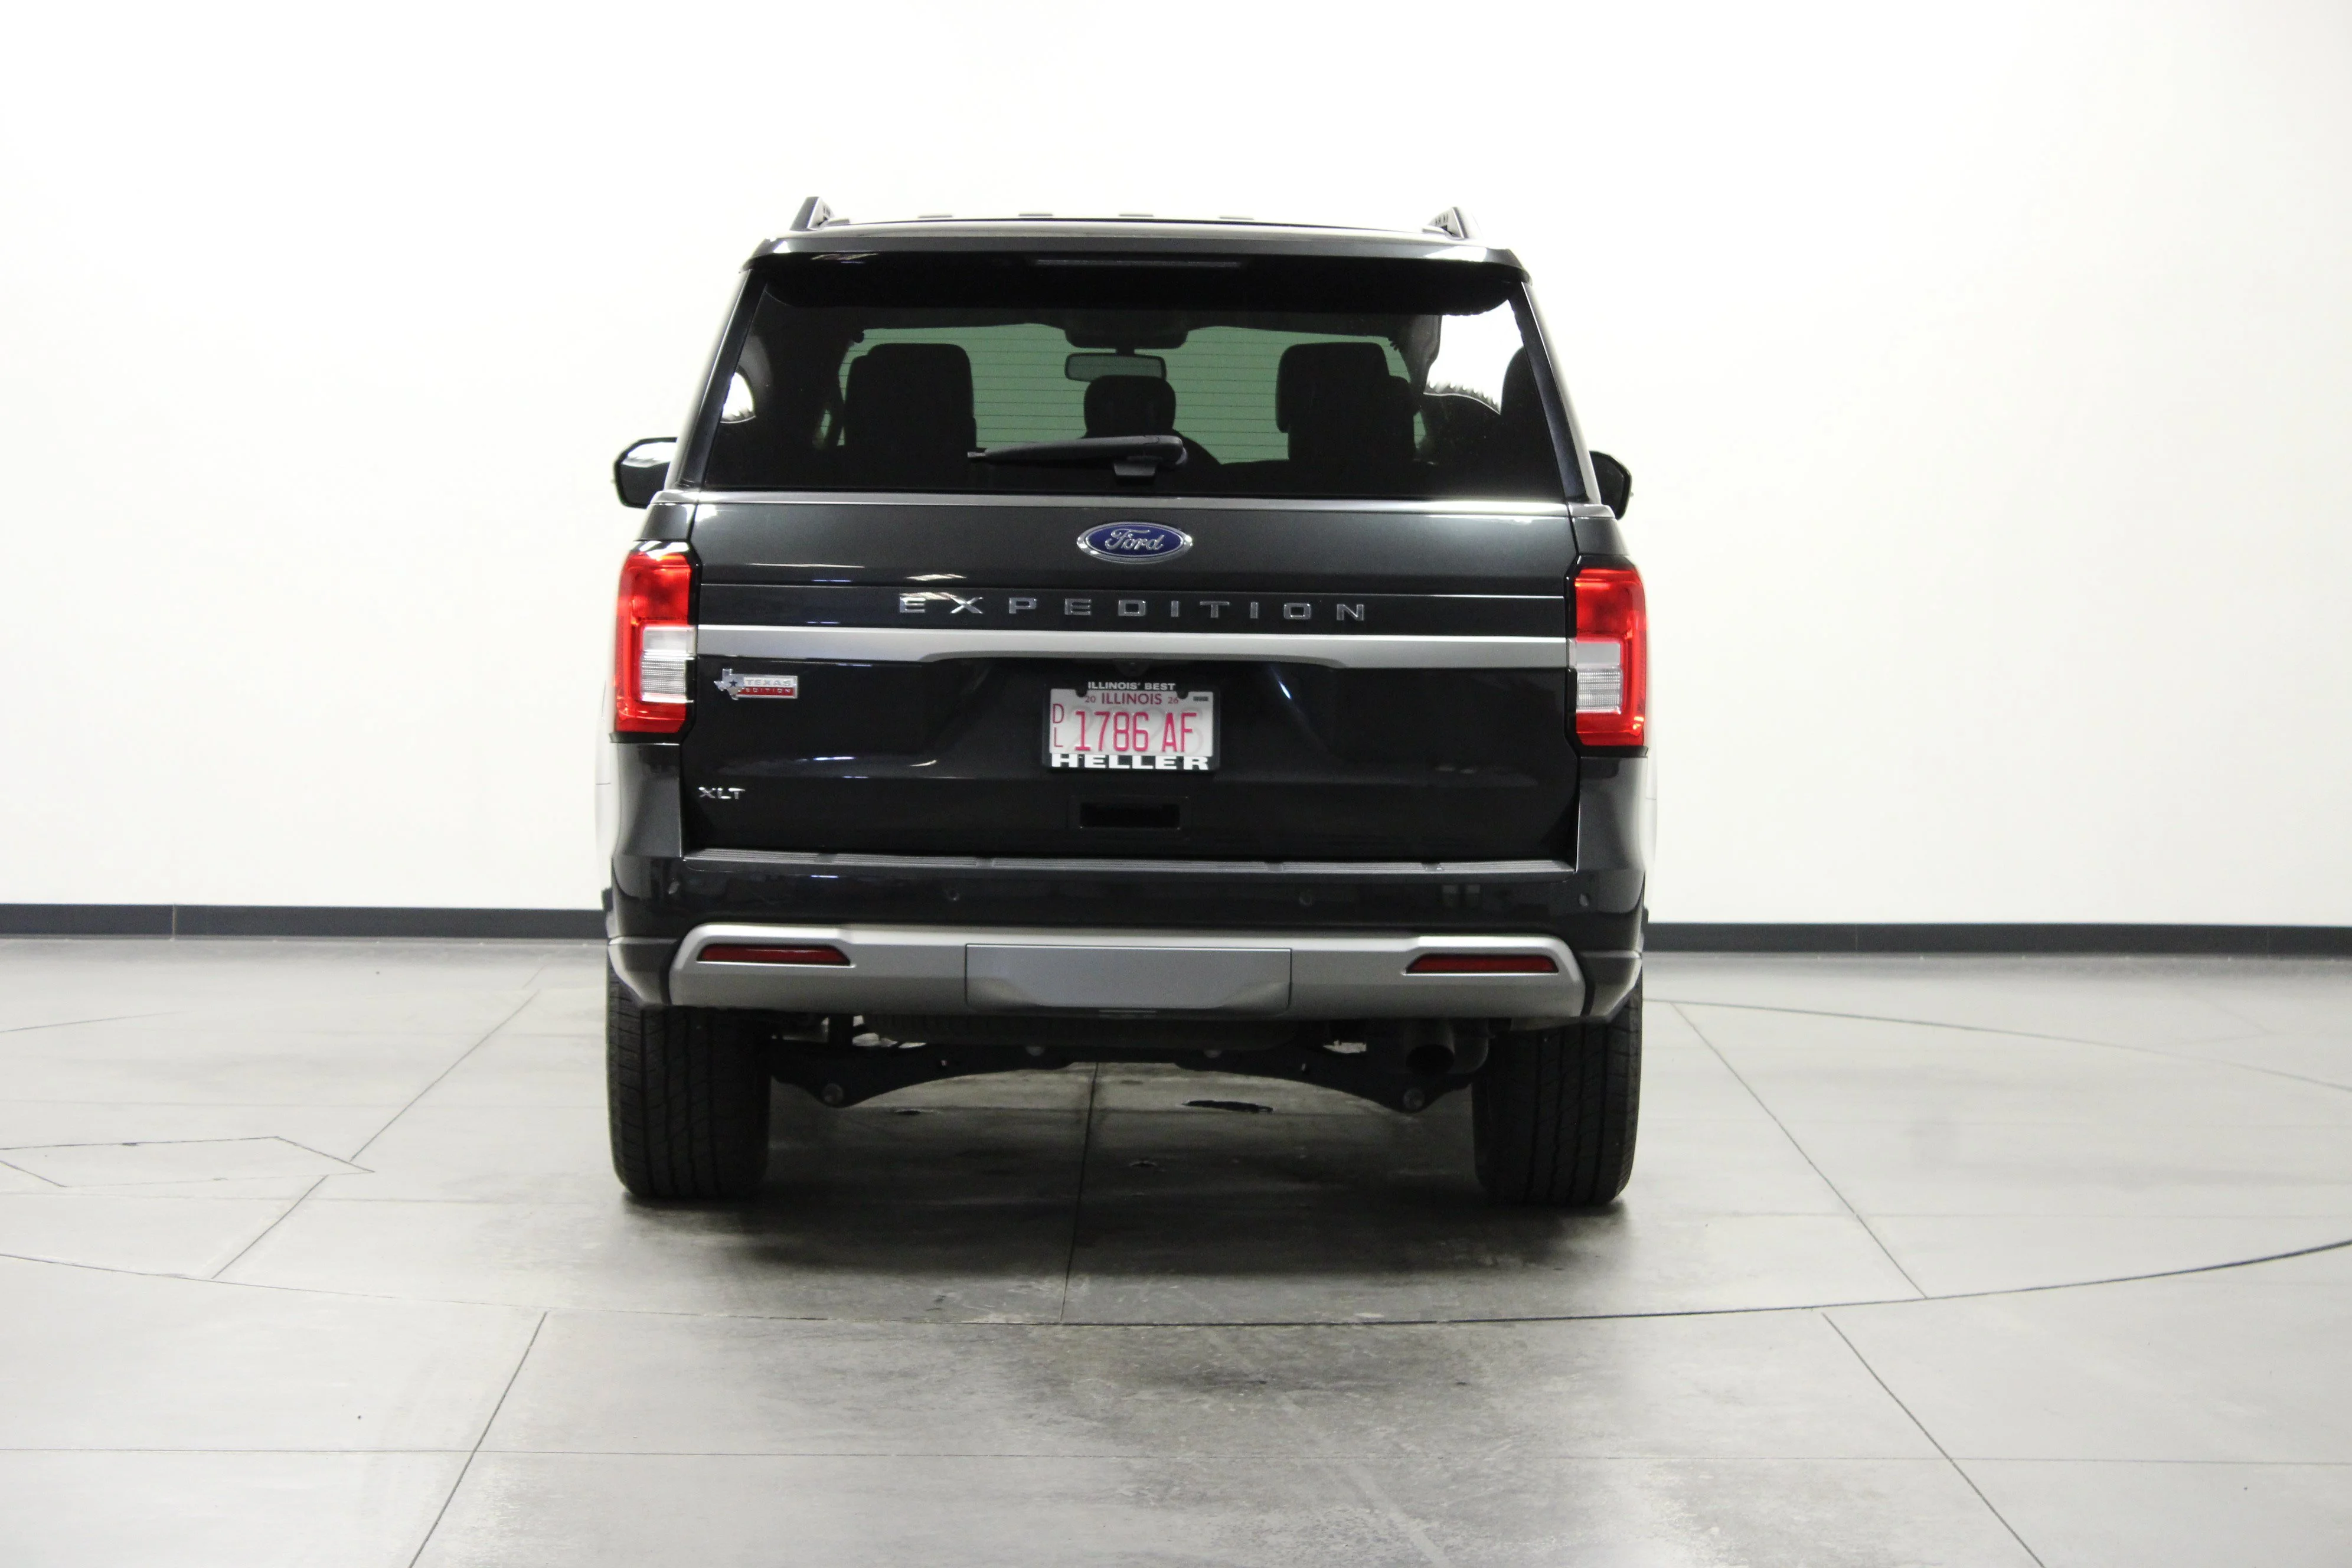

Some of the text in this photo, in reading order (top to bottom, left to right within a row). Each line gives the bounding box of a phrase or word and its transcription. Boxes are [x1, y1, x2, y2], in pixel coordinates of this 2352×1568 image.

[1105, 528, 1164, 550] Ford
[899, 596, 1364, 620] EXPEDITION
[1102, 693, 1162, 704] ILLINOIS
[1074, 711, 1197, 752] 1786 AF
[1051, 754, 1208, 770] HELLER
[699, 787, 745, 799] XLT
